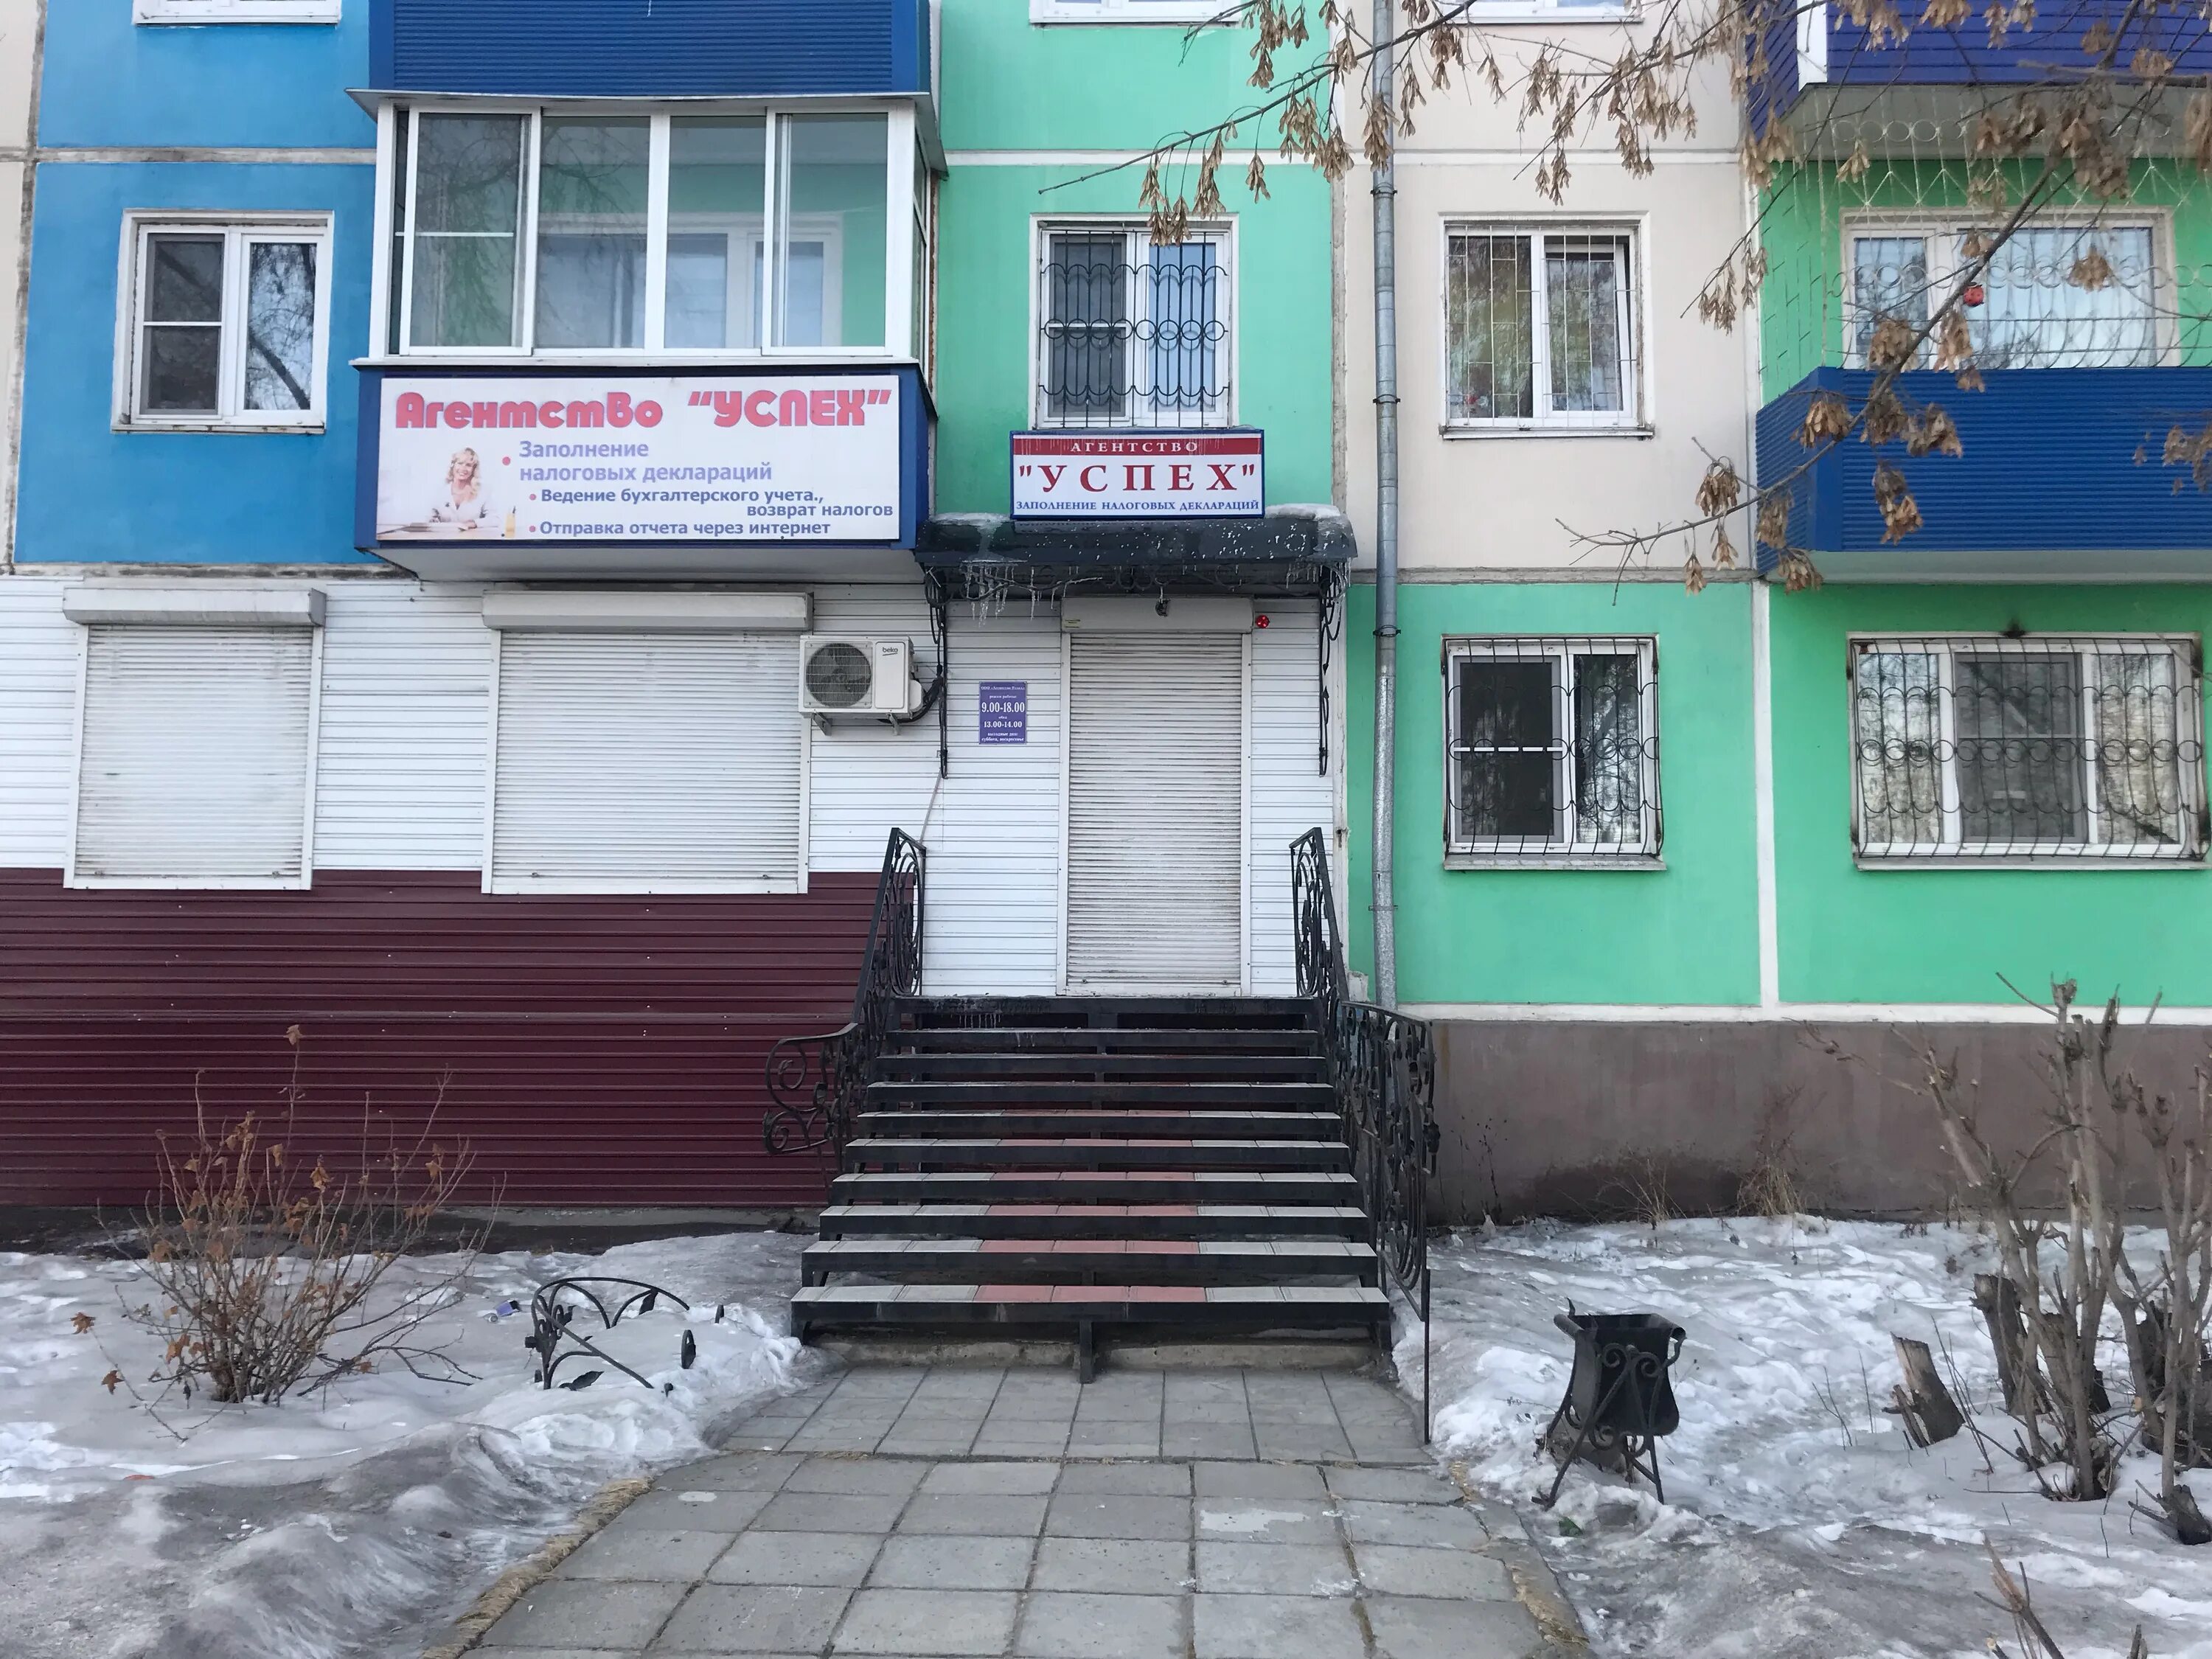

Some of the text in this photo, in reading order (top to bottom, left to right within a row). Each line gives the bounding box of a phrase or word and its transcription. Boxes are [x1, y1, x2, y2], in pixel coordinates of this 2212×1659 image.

[395, 392, 664, 428] Агентство
[519, 441, 650, 457] Заполнение
[1071, 442, 1198, 453] АГЕНТСТВО
[520, 462, 773, 484] налоговых деклараций
[540, 488, 824, 504] Ведение бухгалтерского учета.,
[747, 505, 894, 519] возврат налогов
[1016, 499, 1259, 512] ЗАПОЛНЕНИЕ НАЛОГОВЫХ ДЕКЛАРАЦИЙ
[540, 521, 831, 537] Отправка отчета через интернет
[981, 702, 1025, 712] 9.00-18.00
